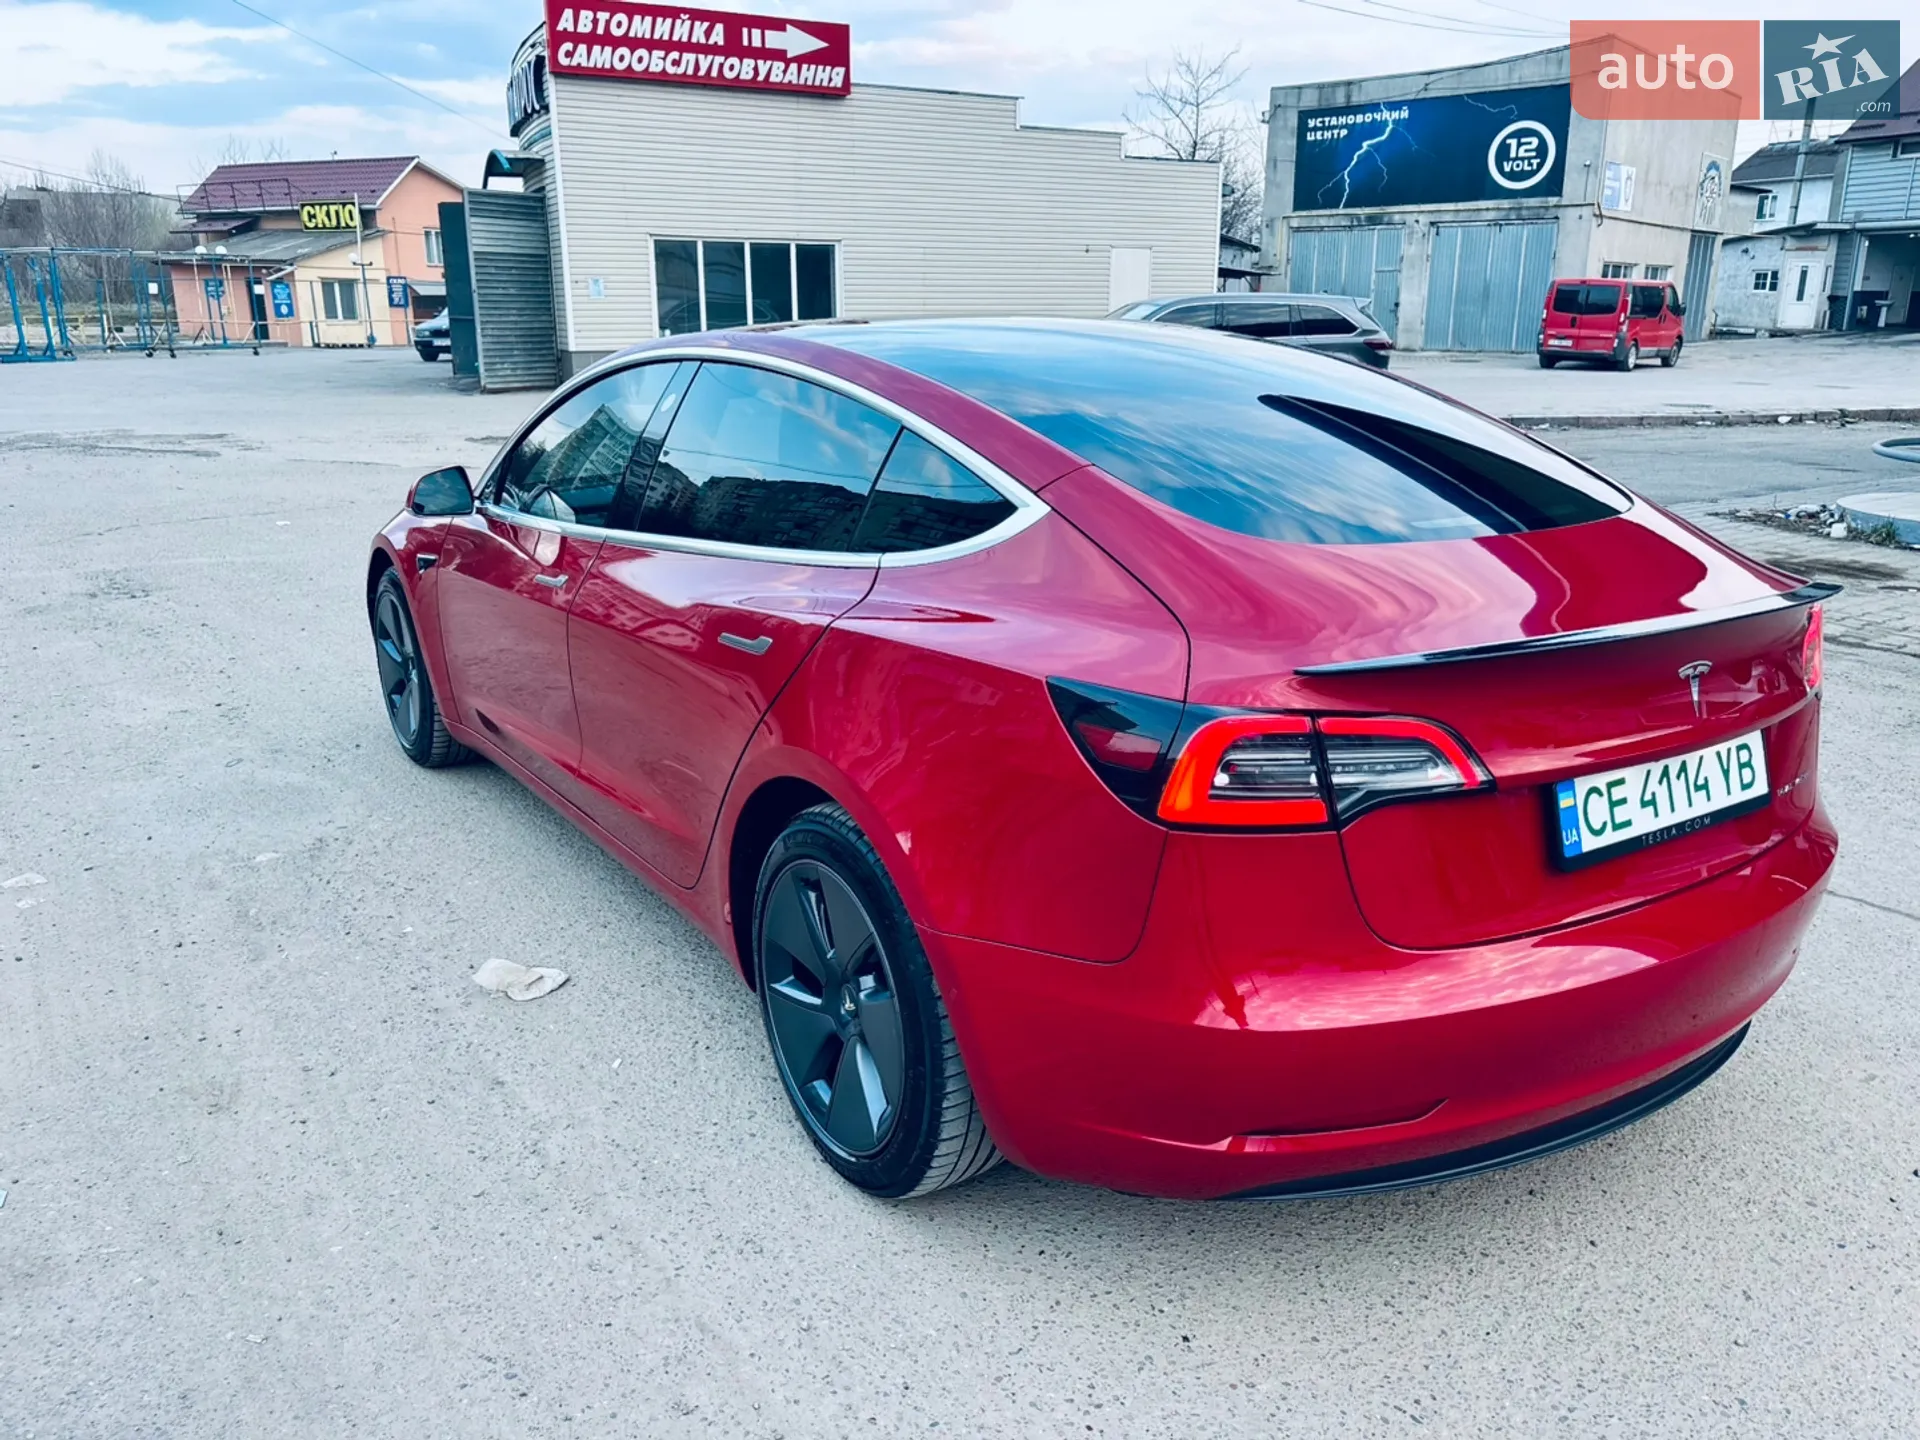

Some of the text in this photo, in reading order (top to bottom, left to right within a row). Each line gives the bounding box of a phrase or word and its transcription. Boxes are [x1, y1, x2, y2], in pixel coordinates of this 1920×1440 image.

[557, 8, 725, 46] АВТОМИЙКА
[557, 42, 846, 88] САМООБСЛУГОВУВАННЯ
[1307, 106, 1409, 128] УСТАНОВОЧНИЙ
[1306, 130, 1348, 141] ЦЕНТР
[1505, 136, 1539, 158] 12
[1503, 158, 1541, 172] VOLT
[302, 204, 358, 228] СКЛО
[1582, 743, 1756, 837] CE 4114 YB
[1562, 828, 1579, 845] UA
[1641, 815, 1711, 846] TESLA.COM
